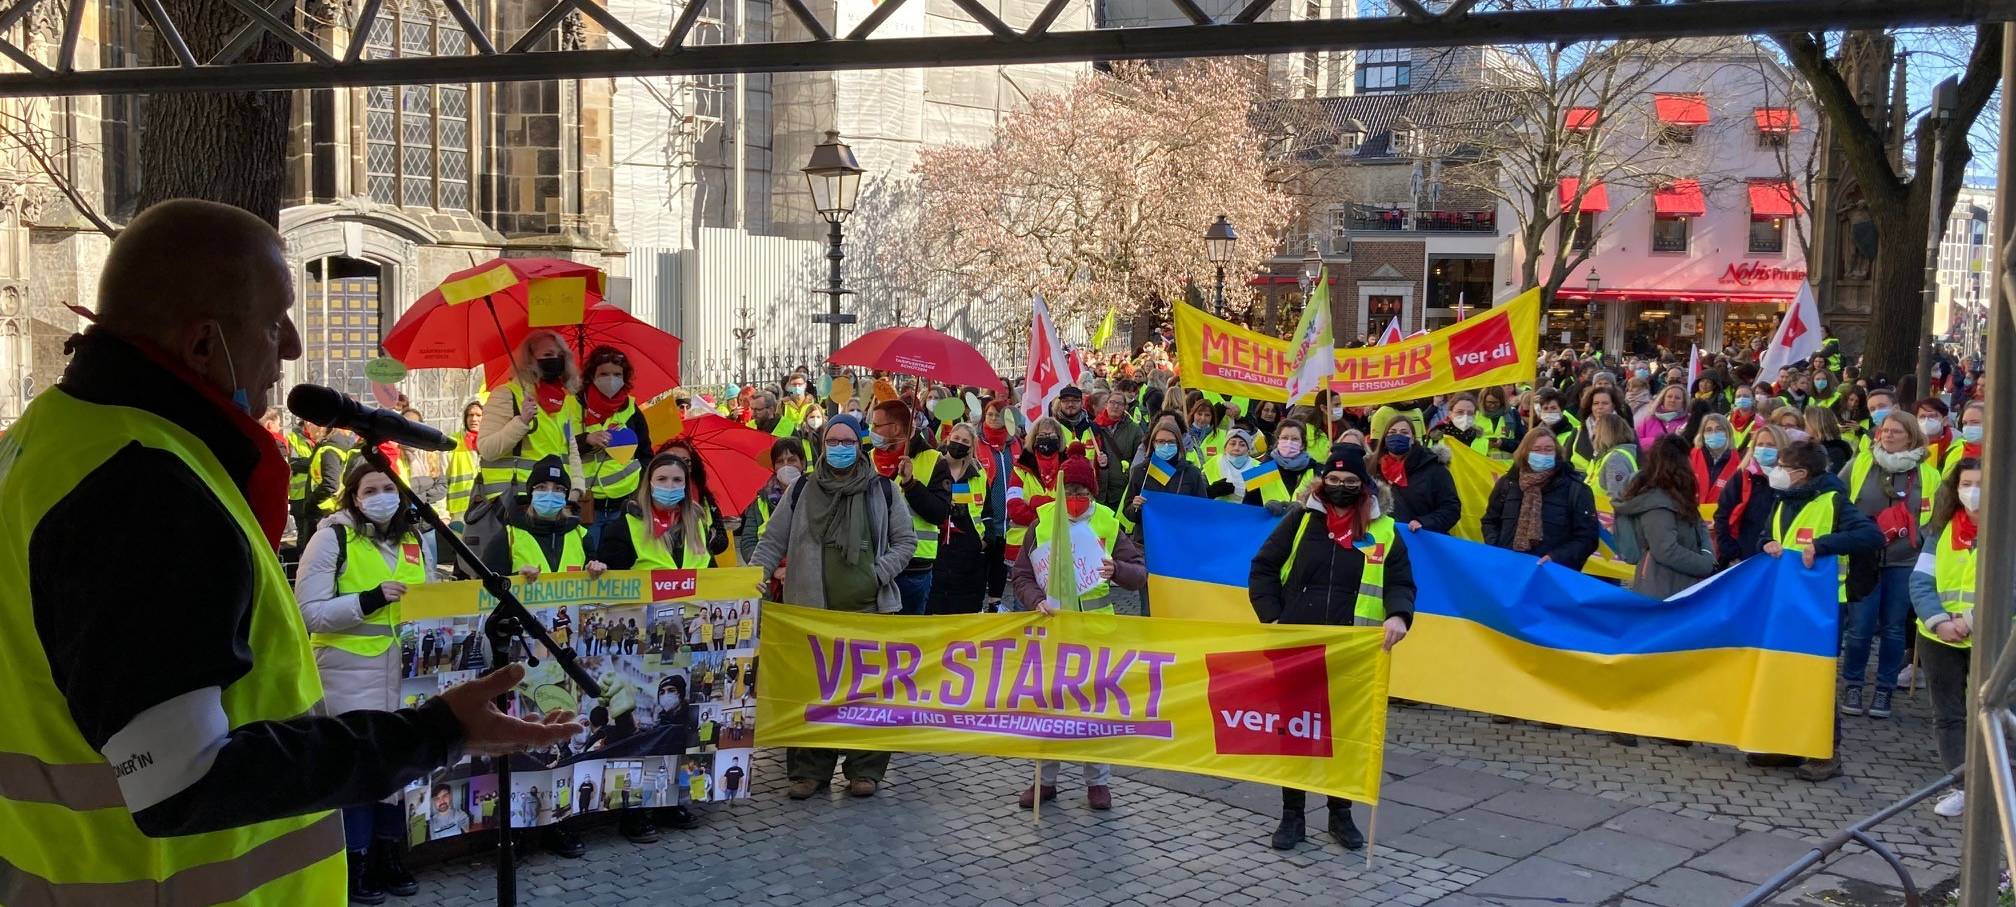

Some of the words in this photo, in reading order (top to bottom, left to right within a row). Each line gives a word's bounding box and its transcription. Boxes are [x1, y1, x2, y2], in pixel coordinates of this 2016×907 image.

[1218, 367, 1283, 386] ENTLASTUNG
[1352, 380, 1407, 392] PERSONAL
[524, 579, 593, 601] BRAUCHT
[597, 578, 641, 598] MEHR
[807, 626, 1176, 719] VER.STÄRKT
[836, 706, 905, 724] SOZIAL-
[911, 711, 946, 724] UND
[952, 714, 1137, 736] ERZIEHUNGSBERUFE
